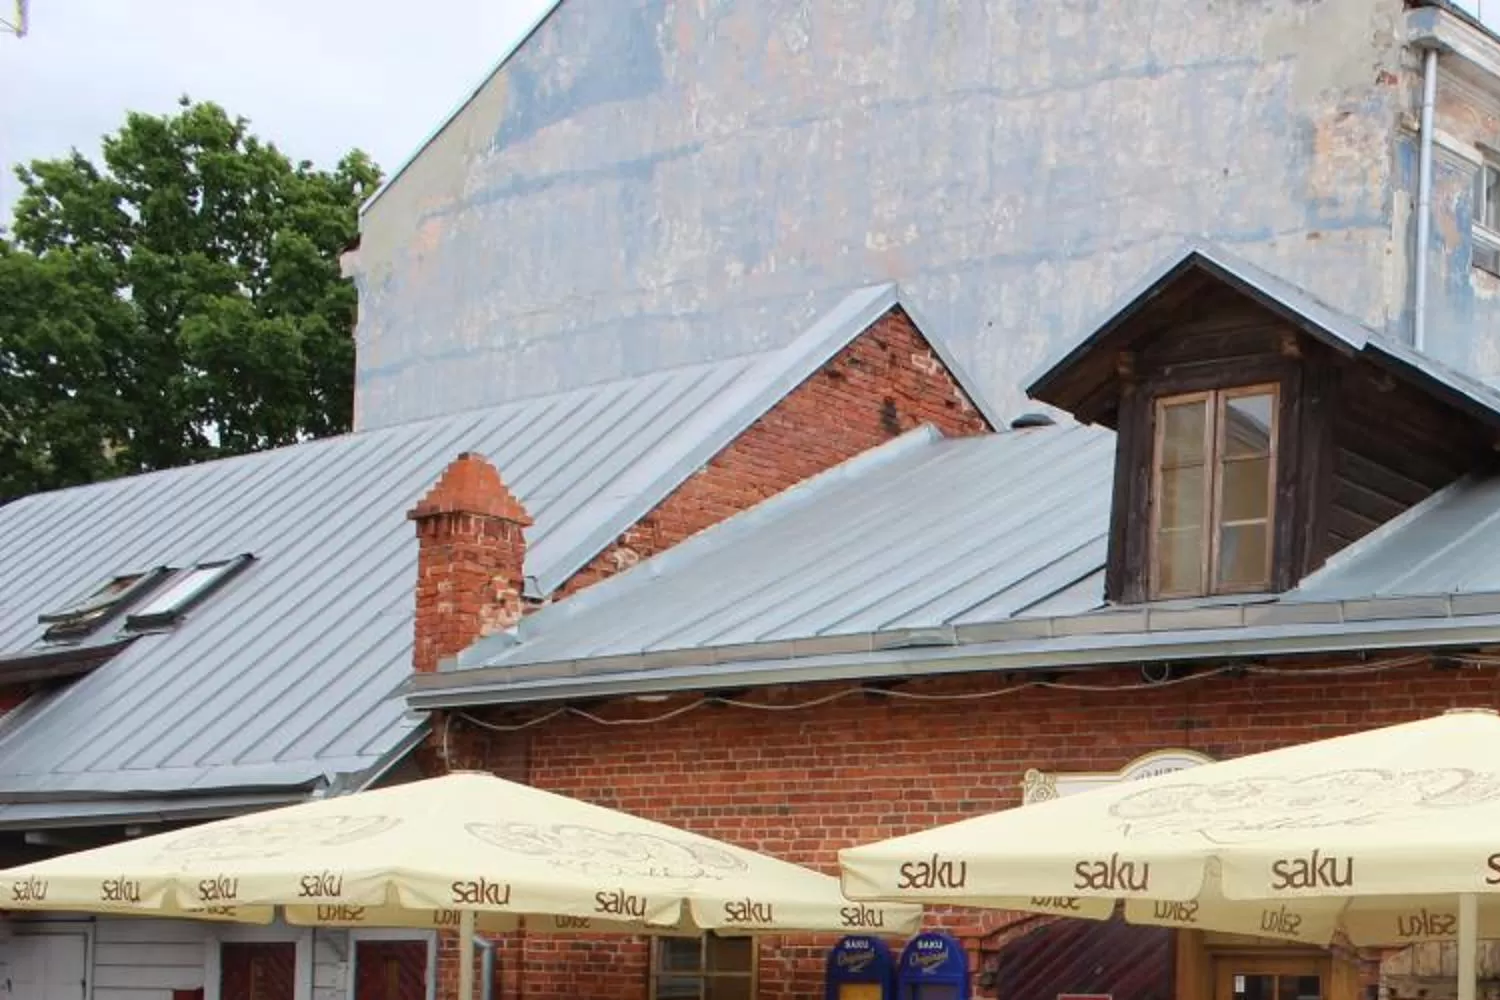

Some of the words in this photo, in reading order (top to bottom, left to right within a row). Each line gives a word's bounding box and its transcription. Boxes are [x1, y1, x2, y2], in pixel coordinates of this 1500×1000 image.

[298, 868, 344, 898] saku
[897, 853, 966, 889] saku
[1073, 852, 1150, 892] saku
[1272, 848, 1355, 892] saku
[11, 874, 49, 901] saku
[101, 874, 141, 903] saku
[199, 874, 239, 901] saku
[451, 877, 511, 906] saku
[594, 888, 647, 917] saku
[724, 897, 774, 924] saku
[839, 901, 885, 928] saku
